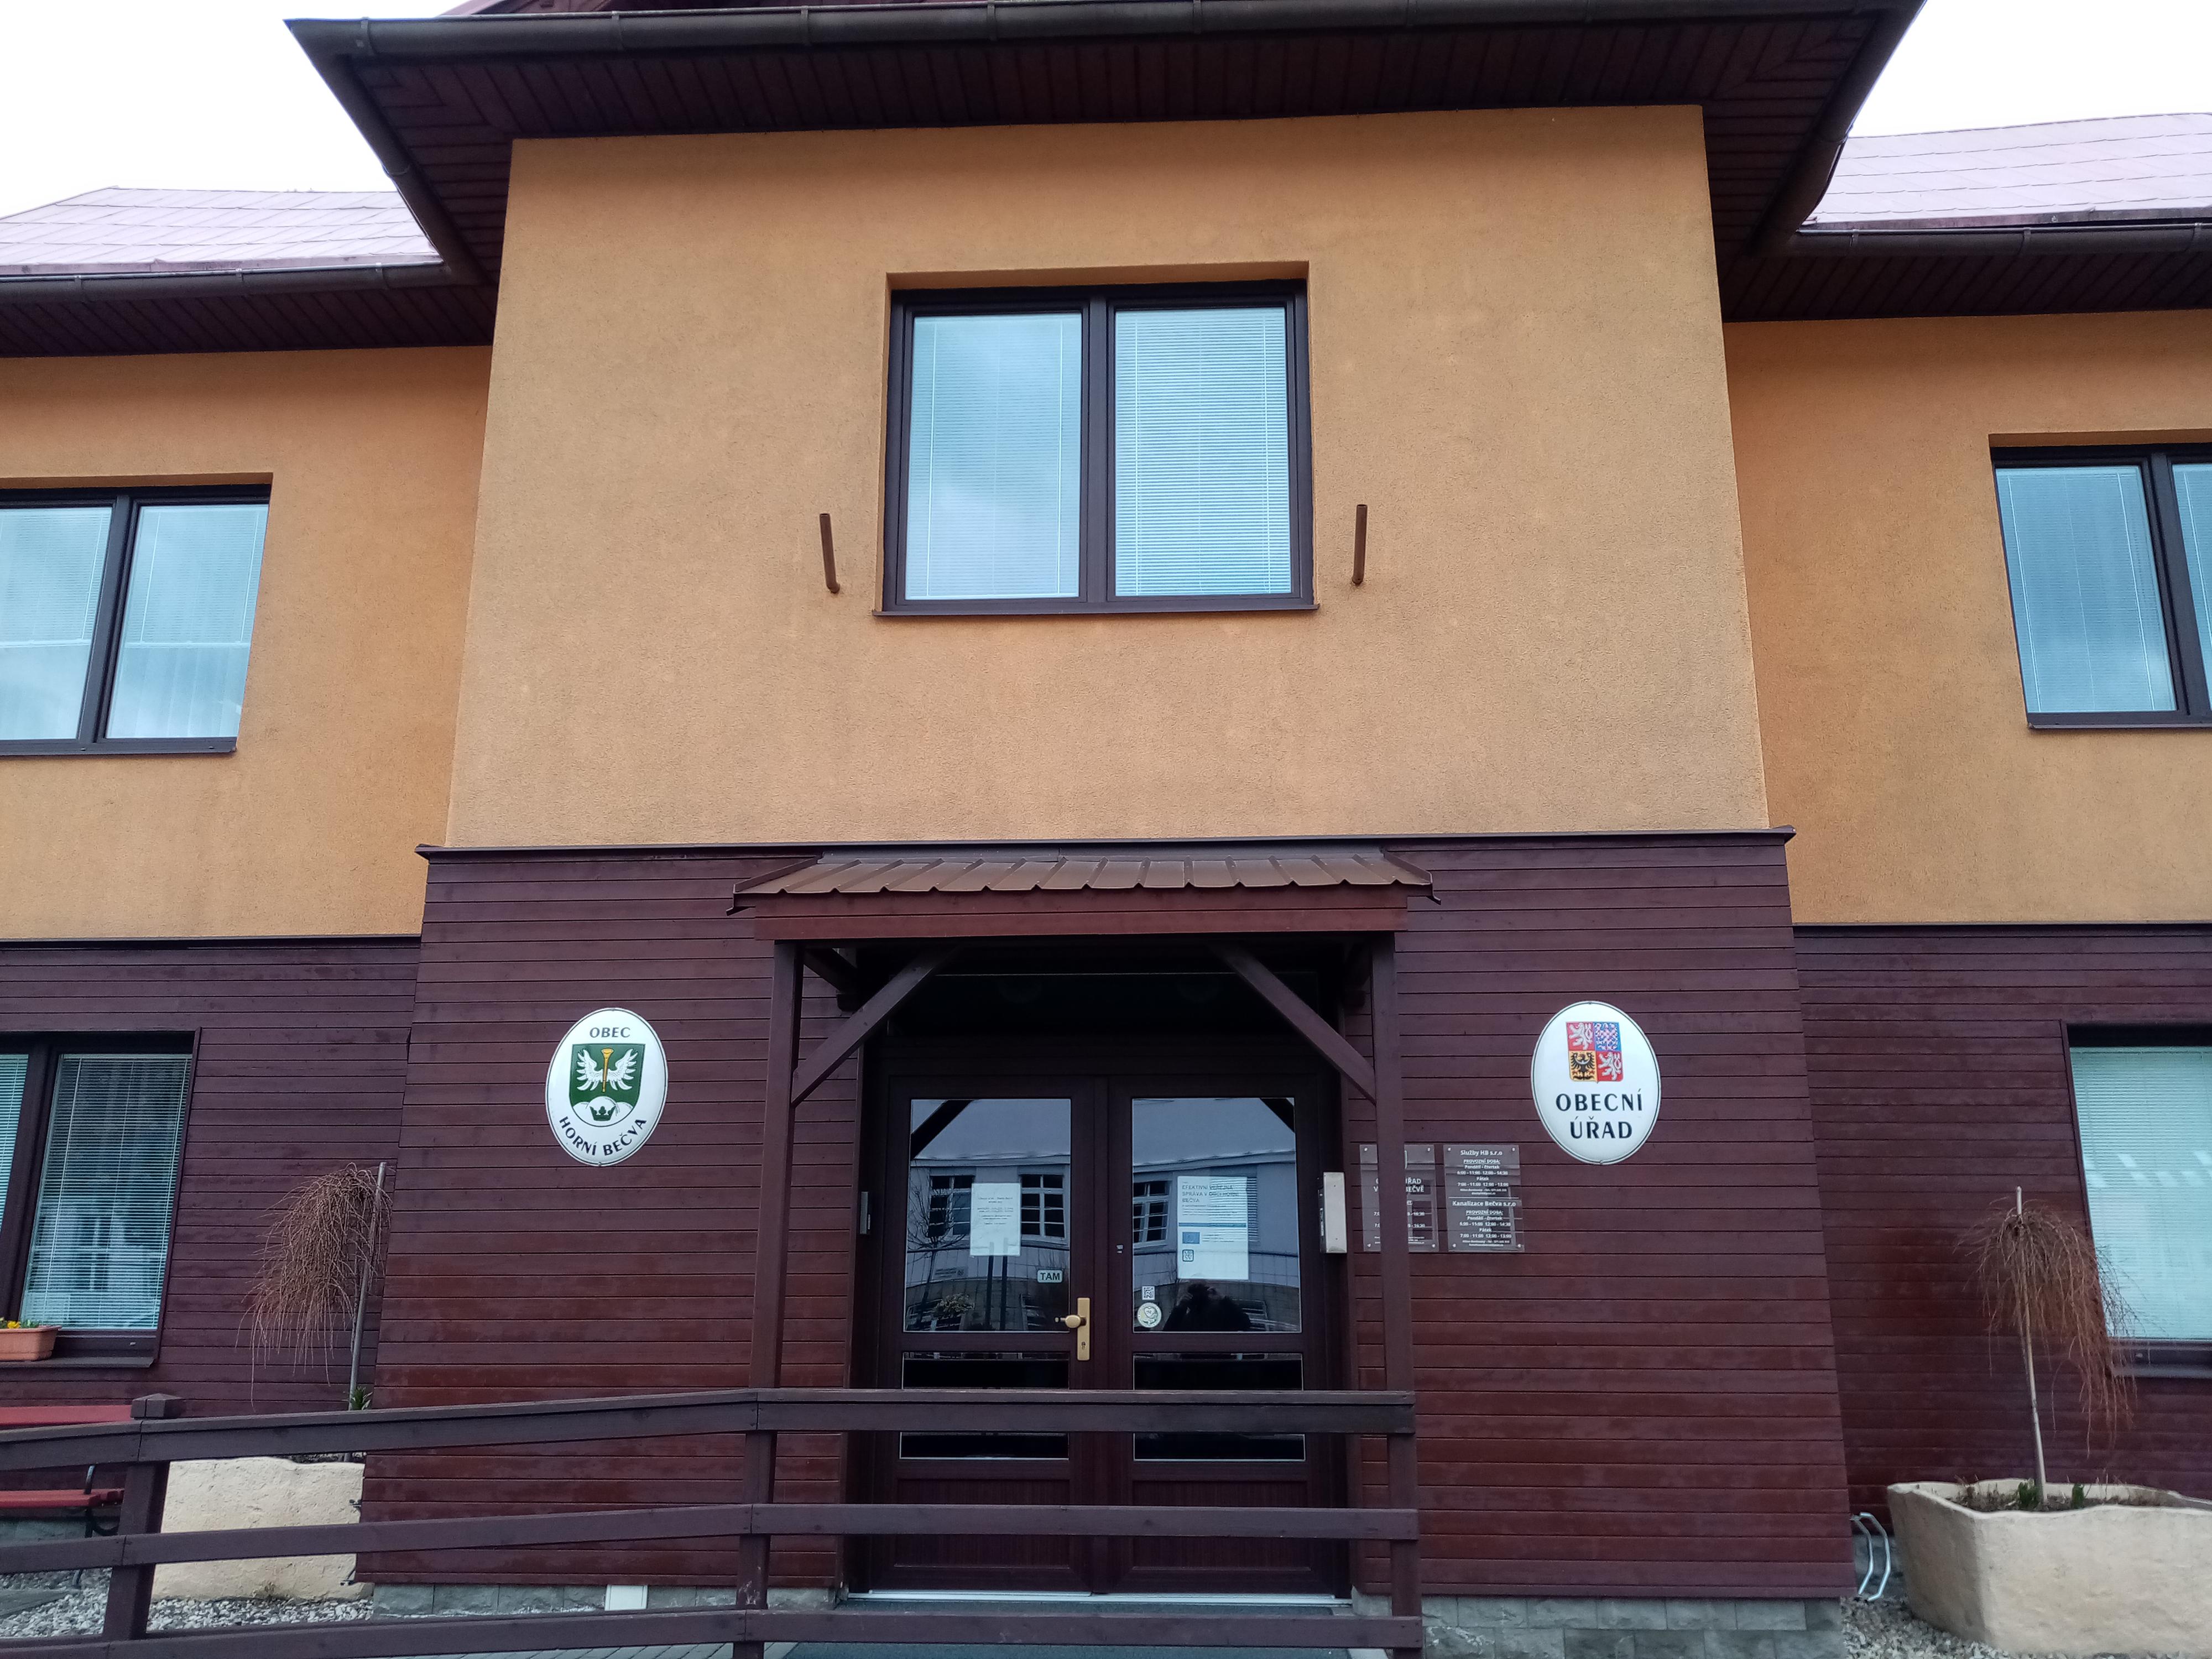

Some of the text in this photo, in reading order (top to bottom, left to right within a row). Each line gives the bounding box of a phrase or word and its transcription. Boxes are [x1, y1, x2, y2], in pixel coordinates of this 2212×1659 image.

[589, 1027, 630, 1038] OBEC
[1556, 1088, 1642, 1112] OBECNÍ
[559, 1116, 647, 1156] HORNÍ BEČVA
[1570, 1116, 1632, 1139] ÚŘAD
